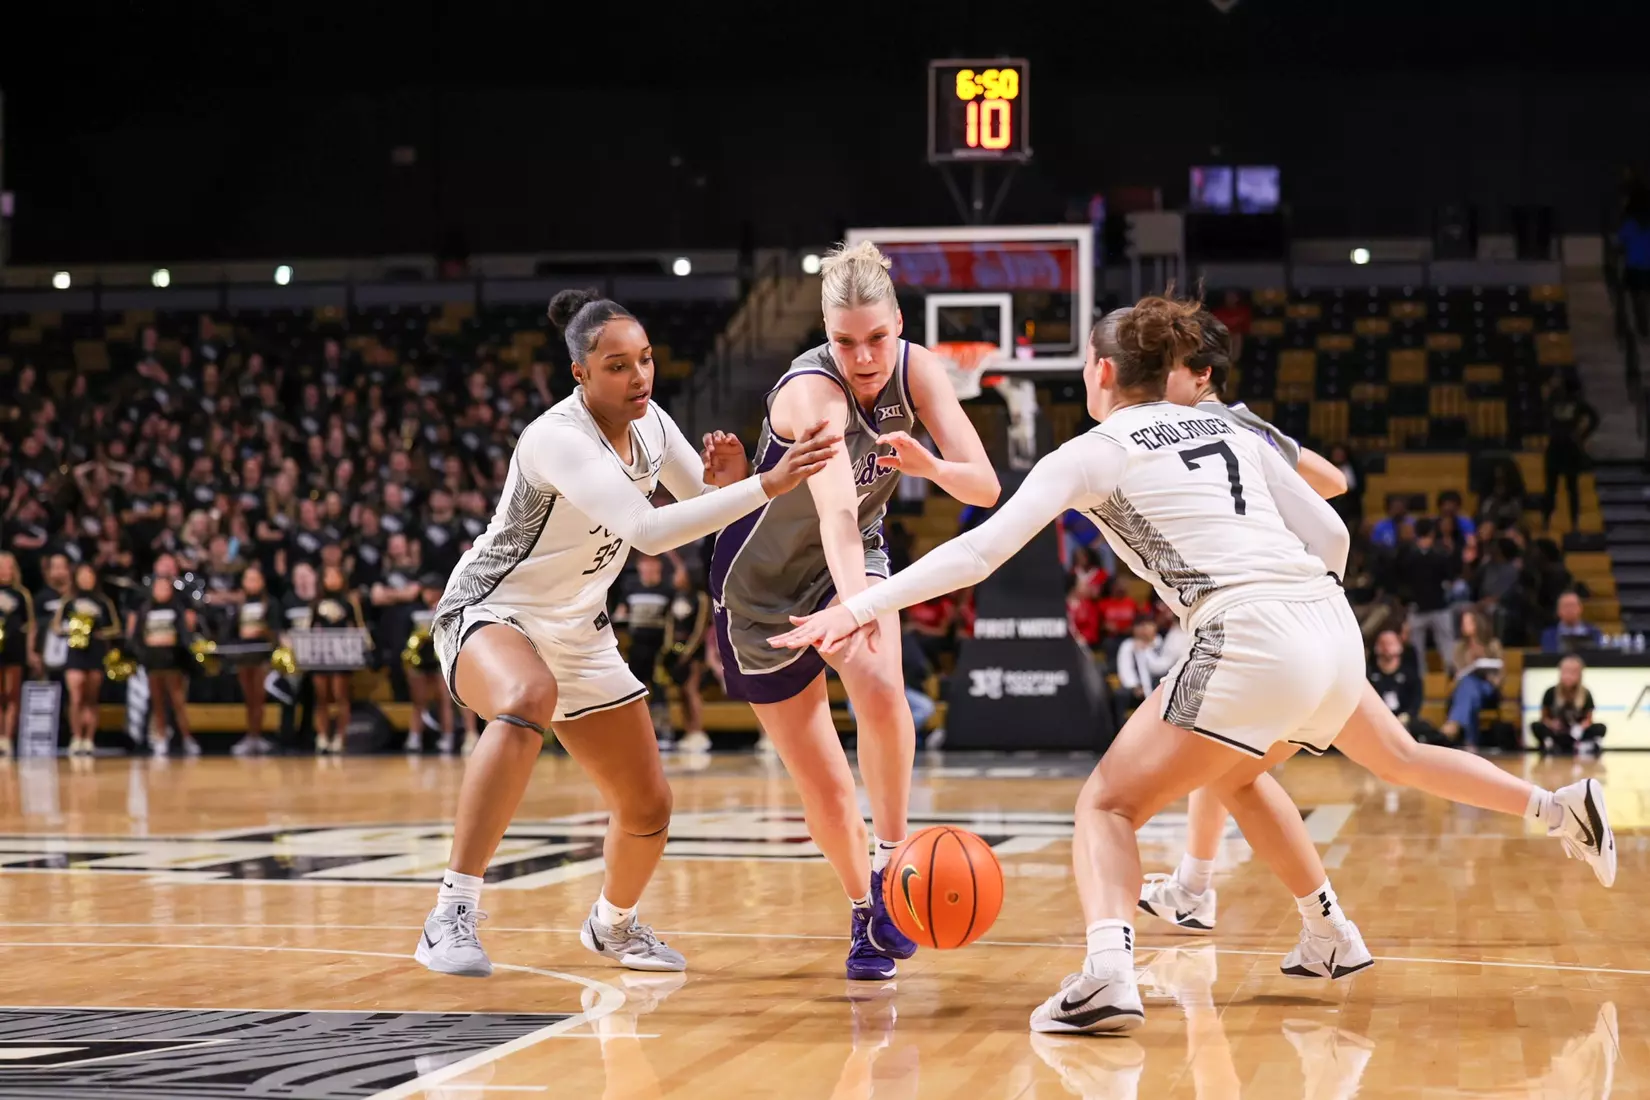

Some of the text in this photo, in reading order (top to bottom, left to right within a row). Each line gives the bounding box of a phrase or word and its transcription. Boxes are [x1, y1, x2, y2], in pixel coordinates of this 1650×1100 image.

[956, 69, 1019, 100] 6:50
[966, 99, 1011, 149] 10
[1178, 440, 1246, 516] 7
[582, 537, 624, 576] 33
